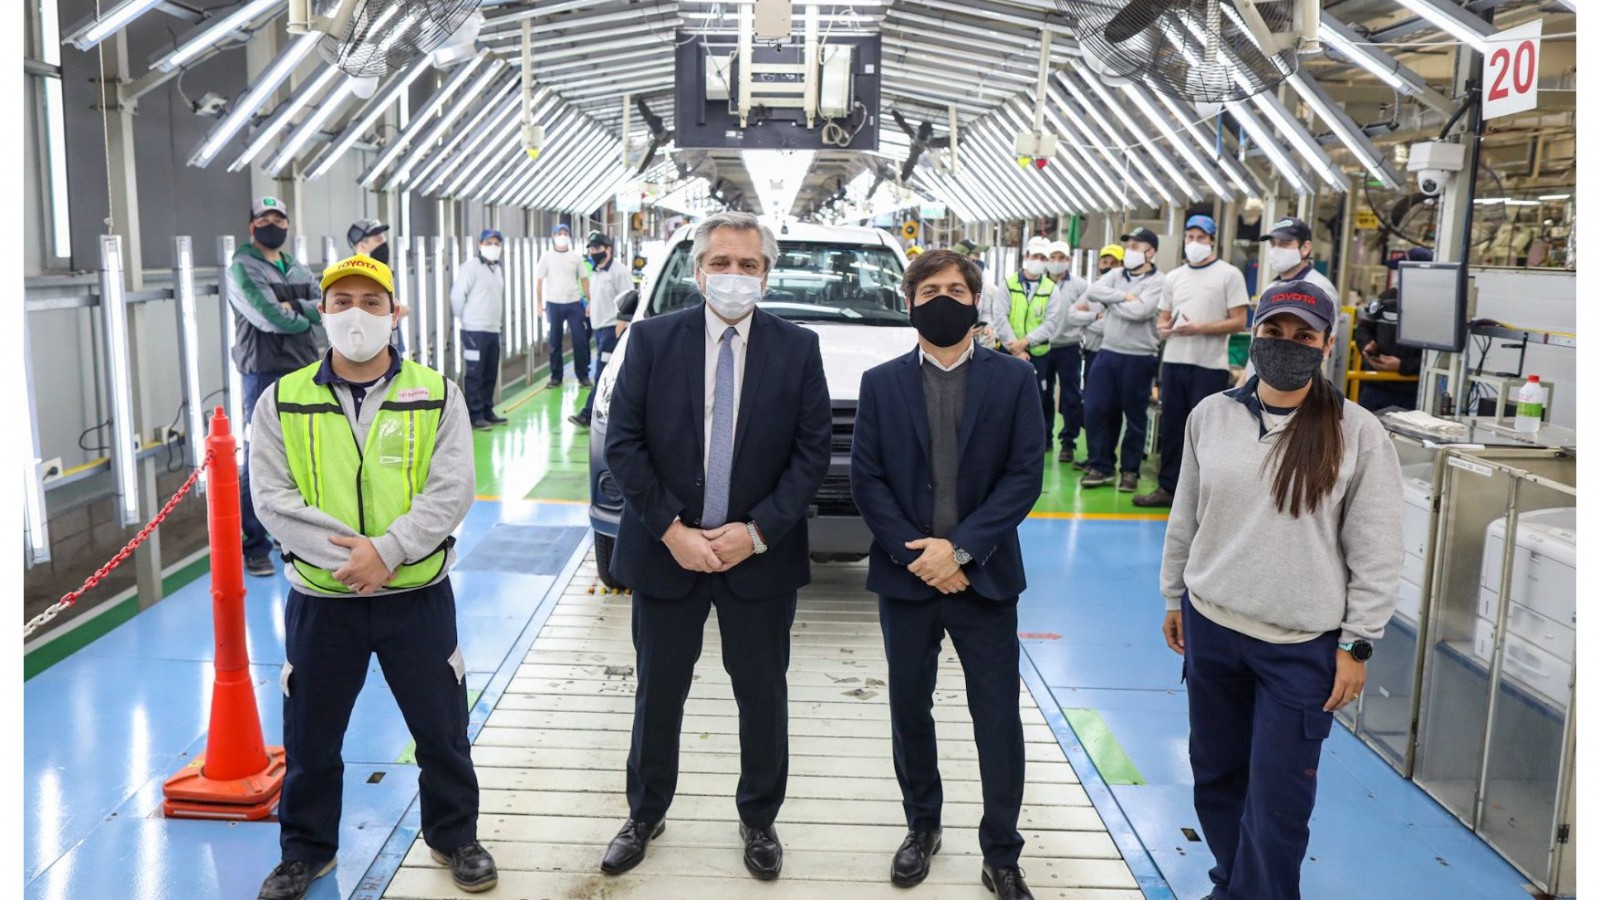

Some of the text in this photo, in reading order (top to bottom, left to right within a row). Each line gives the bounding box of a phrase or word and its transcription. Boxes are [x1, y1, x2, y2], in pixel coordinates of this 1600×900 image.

[1488, 40, 1536, 102] 20
[338, 260, 378, 272] TOYOTA
[1270, 292, 1317, 305] TOYOTA
